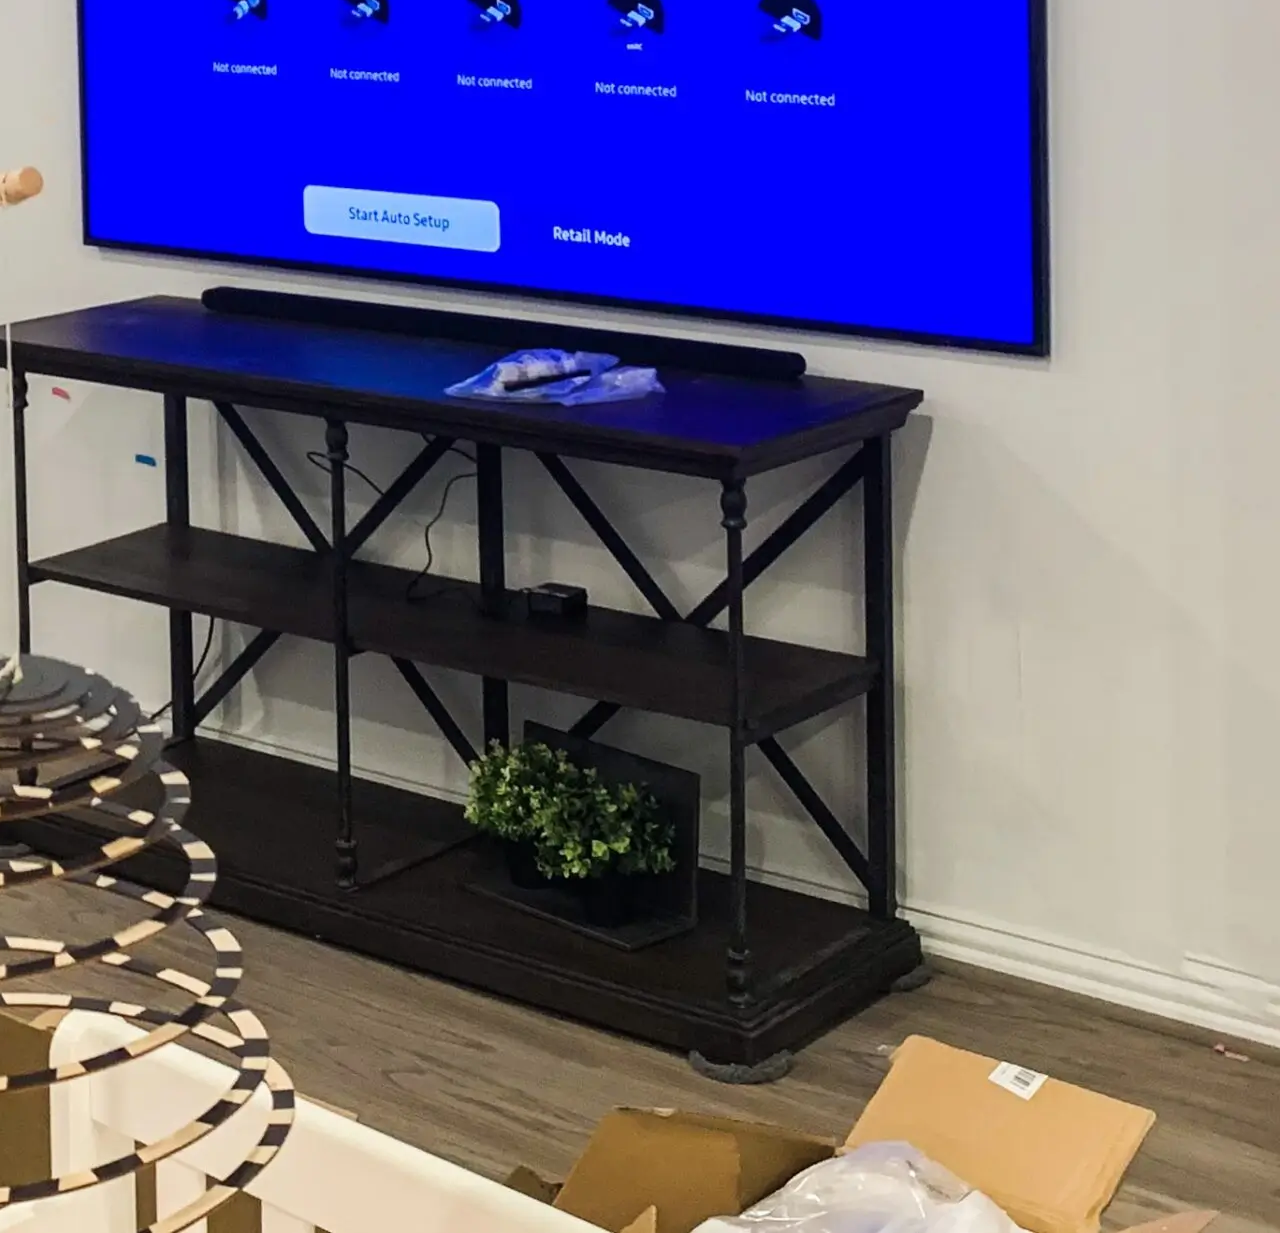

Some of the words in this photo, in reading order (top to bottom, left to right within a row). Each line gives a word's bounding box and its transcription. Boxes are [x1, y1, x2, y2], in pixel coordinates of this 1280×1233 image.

[212, 62, 230, 73] Not
[230, 64, 278, 76] connected
[329, 67, 348, 80] Not
[348, 70, 400, 83] connected
[456, 74, 476, 87] Not
[477, 77, 533, 90] connected
[594, 81, 616, 94] Not
[617, 84, 677, 98] connected
[745, 89, 768, 103] Not
[769, 92, 836, 107] connected
[348, 206, 379, 223] Start
[380, 209, 411, 226] Auto
[412, 212, 450, 233] Setup
[552, 225, 592, 244] Retail
[593, 229, 631, 248] Mode
